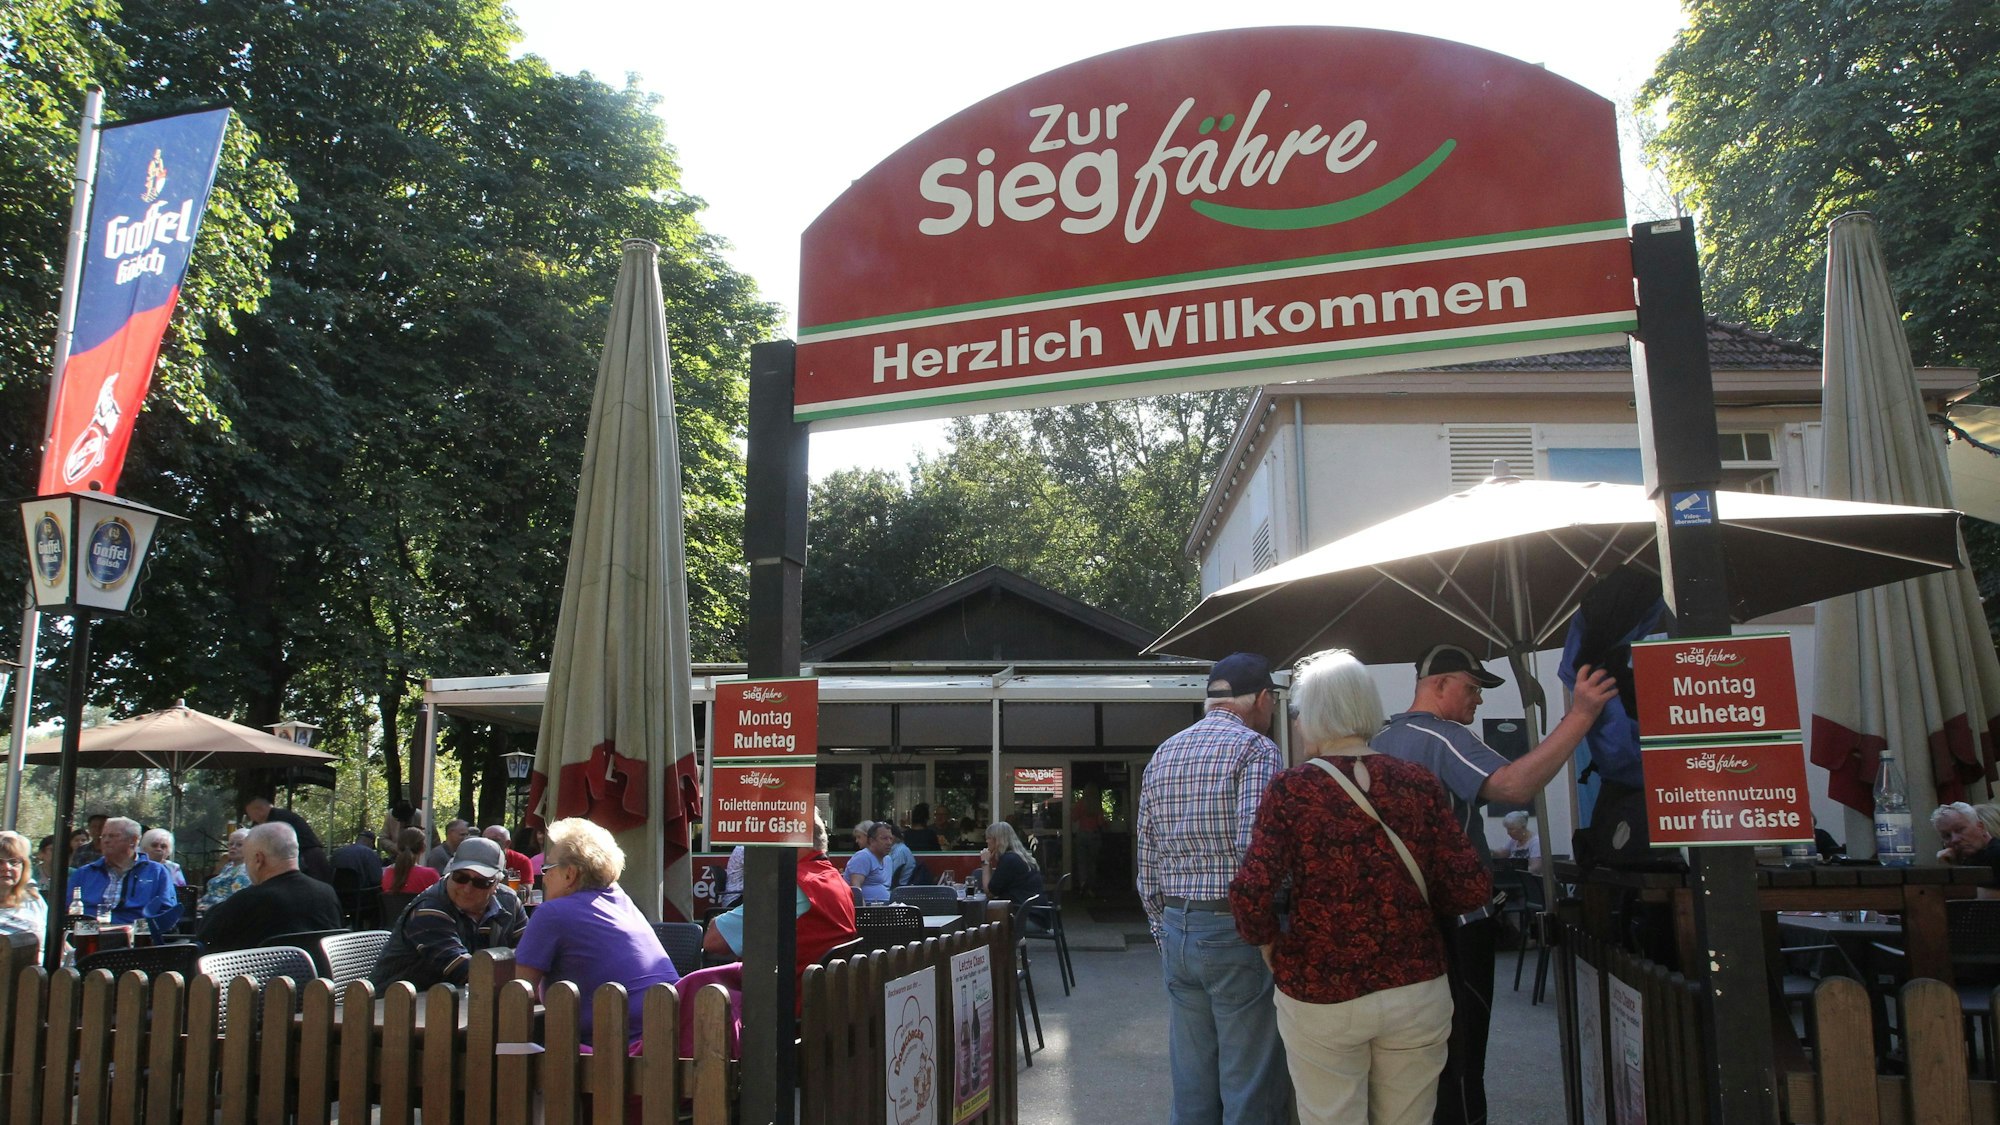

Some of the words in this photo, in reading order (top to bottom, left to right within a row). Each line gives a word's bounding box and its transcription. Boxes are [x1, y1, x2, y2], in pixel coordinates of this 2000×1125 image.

[1029, 102, 1129, 153] Zur
[105, 199, 193, 260] Gaffel
[873, 317, 1103, 385] Herzlich
[1122, 275, 1528, 351] Willkommen
[38, 540, 61, 555] Gaffel
[93, 542, 127, 561] Gaffel
[1690, 647, 1705, 655] Zur
[1673, 676, 1756, 698] Montag
[739, 710, 792, 729] Montag
[1669, 703, 1766, 727] Ruhetag
[734, 731, 796, 752] Ruhetag
[1701, 752, 1716, 760] Zur
[1655, 786, 1797, 804] Toilettennutzung
[718, 798, 807, 814] Toilettennutzung
[718, 820, 742, 833] nur
[745, 816, 766, 833] für
[768, 817, 807, 833] Gäste
[1659, 815, 1697, 830] nur
[1701, 809, 1734, 830] für
[1739, 808, 1800, 828] Gäste
